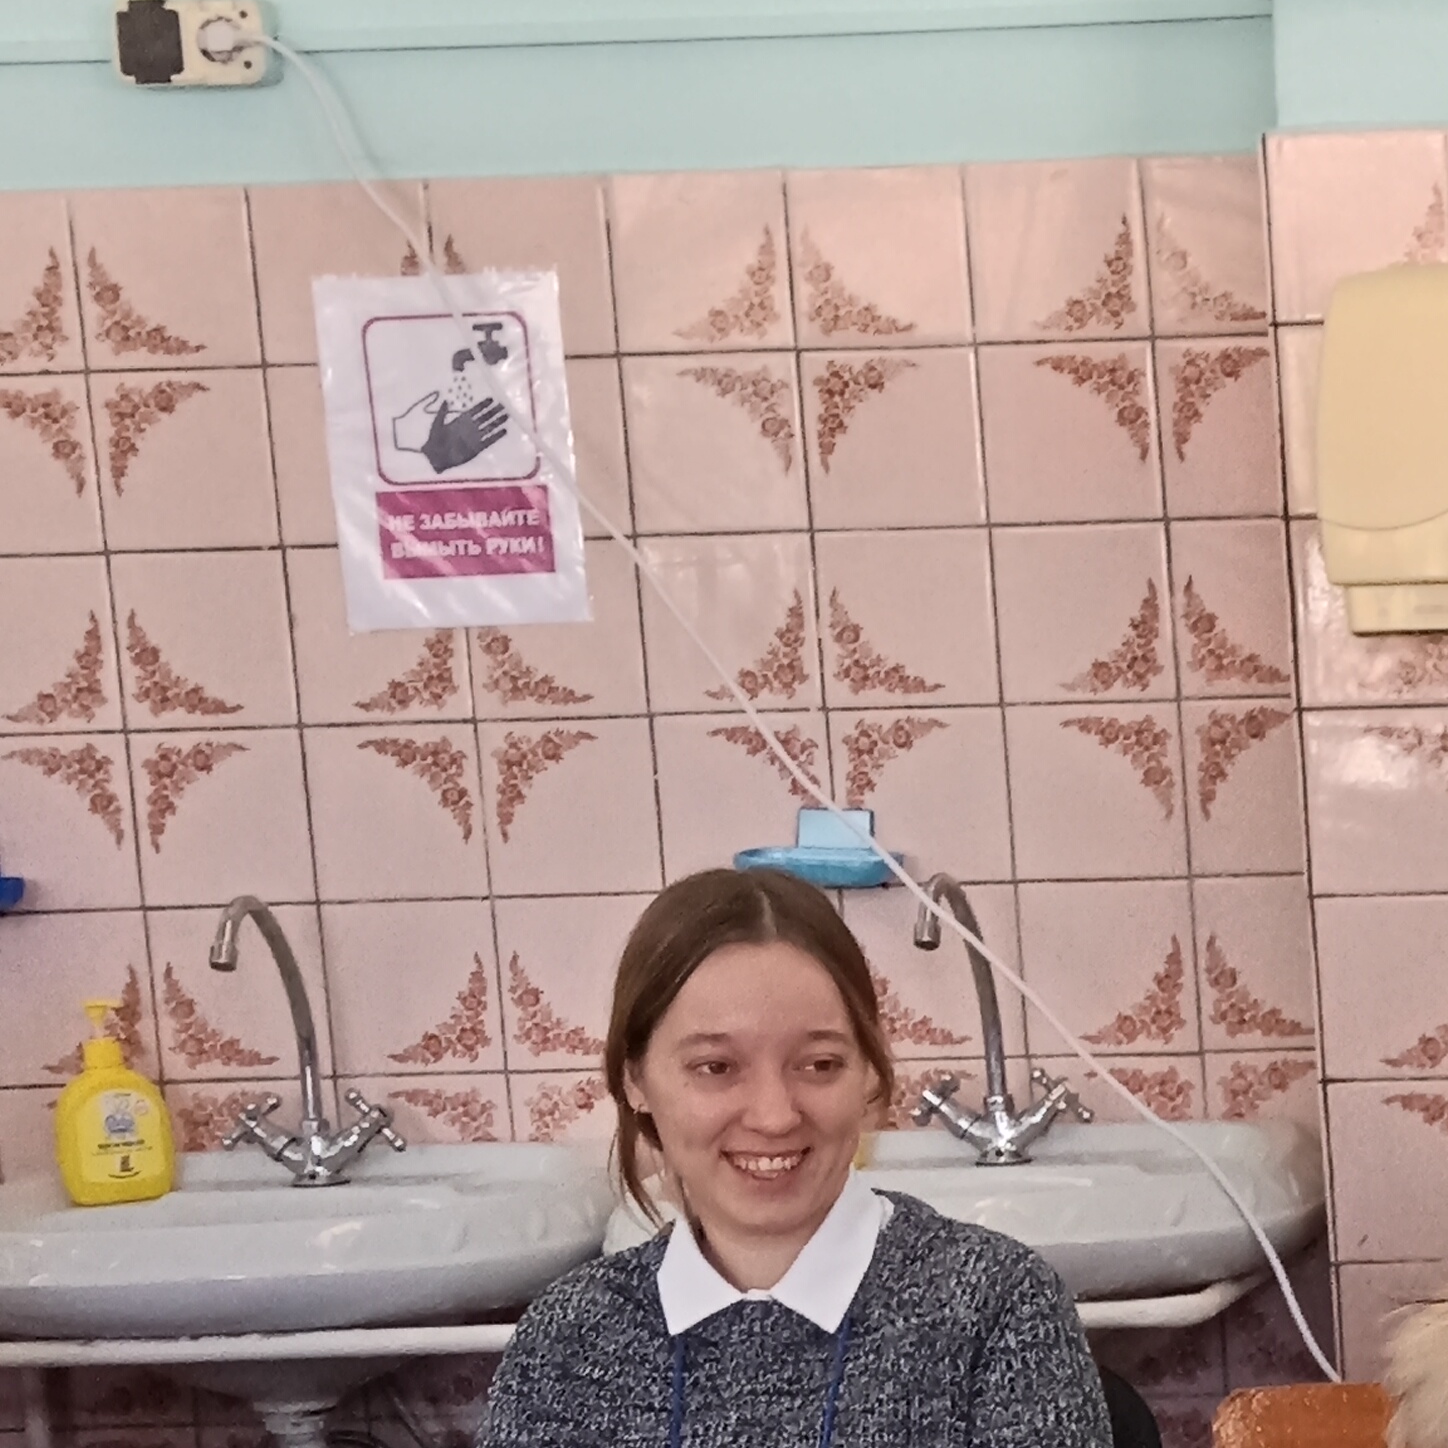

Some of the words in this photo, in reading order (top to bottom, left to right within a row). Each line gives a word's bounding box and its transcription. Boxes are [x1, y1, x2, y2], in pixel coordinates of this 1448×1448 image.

[388, 513, 415, 532] НЕ
[419, 508, 541, 530] ЗАБЫВАЙТЕ
[486, 536, 545, 555] РУКИ!
